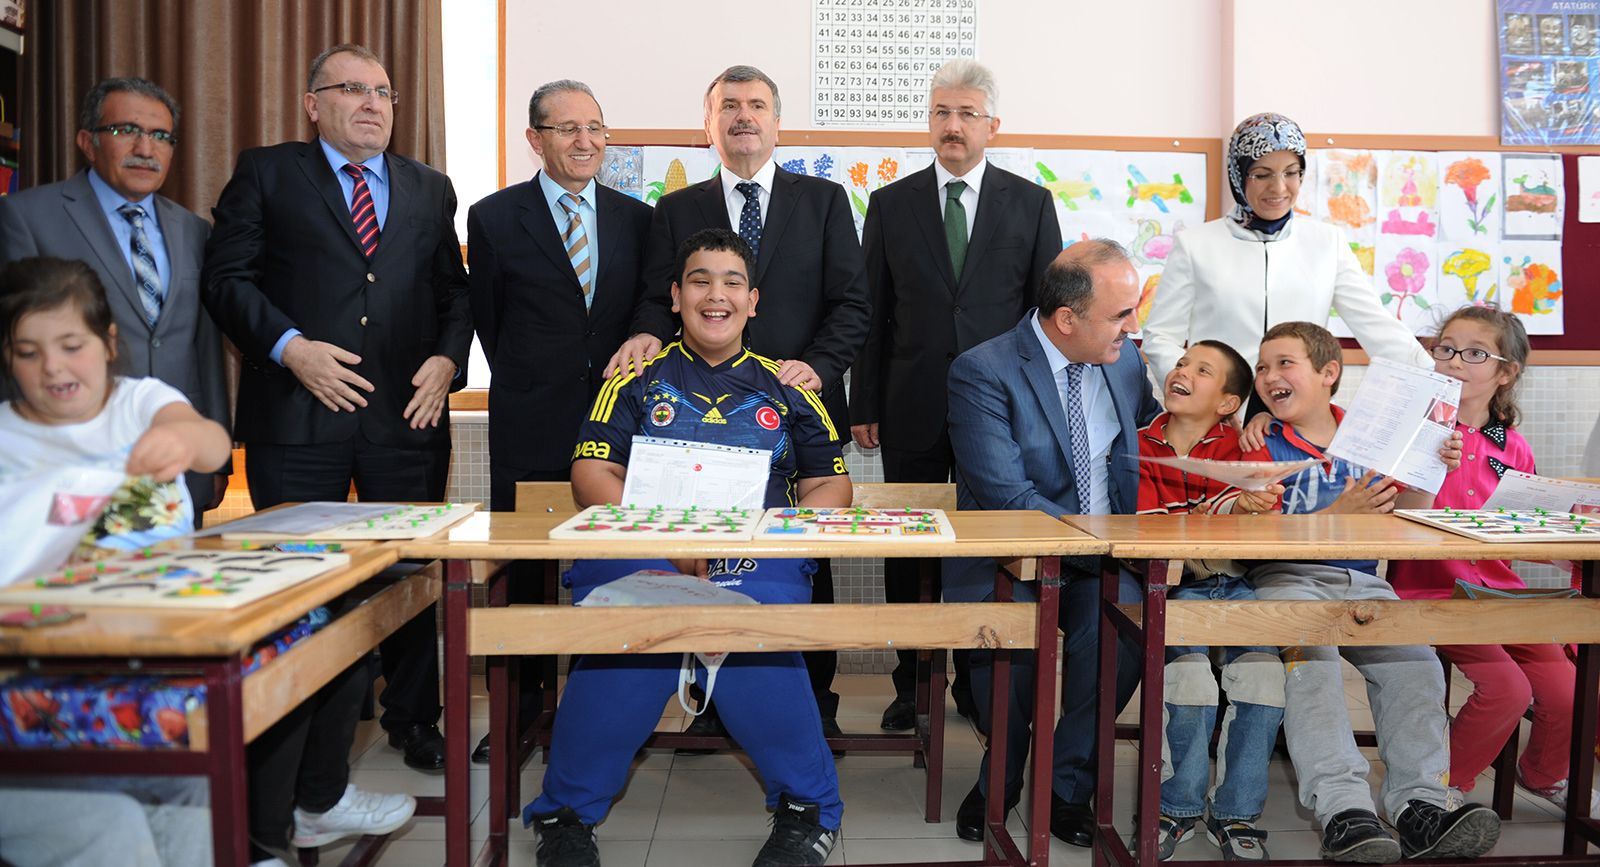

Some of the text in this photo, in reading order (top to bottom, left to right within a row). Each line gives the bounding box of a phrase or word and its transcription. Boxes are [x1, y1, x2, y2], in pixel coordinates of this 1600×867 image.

[960, 0, 972, 8] 30
[1552, 0, 1599, 10] ATATÜRK
[820, 12, 972, 24] 31 32 33 34 35 36 37 38 39 40
[818, 28, 972, 40] 41 42 43 44 45 46 47 48 49 50
[818, 44, 972, 56] 51 52 53 54 55 56 57 58 59 60
[818, 60, 940, 72] 61 62 63 64 65 66 67 68
[818, 76, 924, 86] 71 72 73 74 75 76 77
[818, 92, 924, 104] 81 82 83 84 85 86 87
[818, 108, 924, 118] 91 92 93 94 95 96 97
[702, 417, 727, 425] adidas
